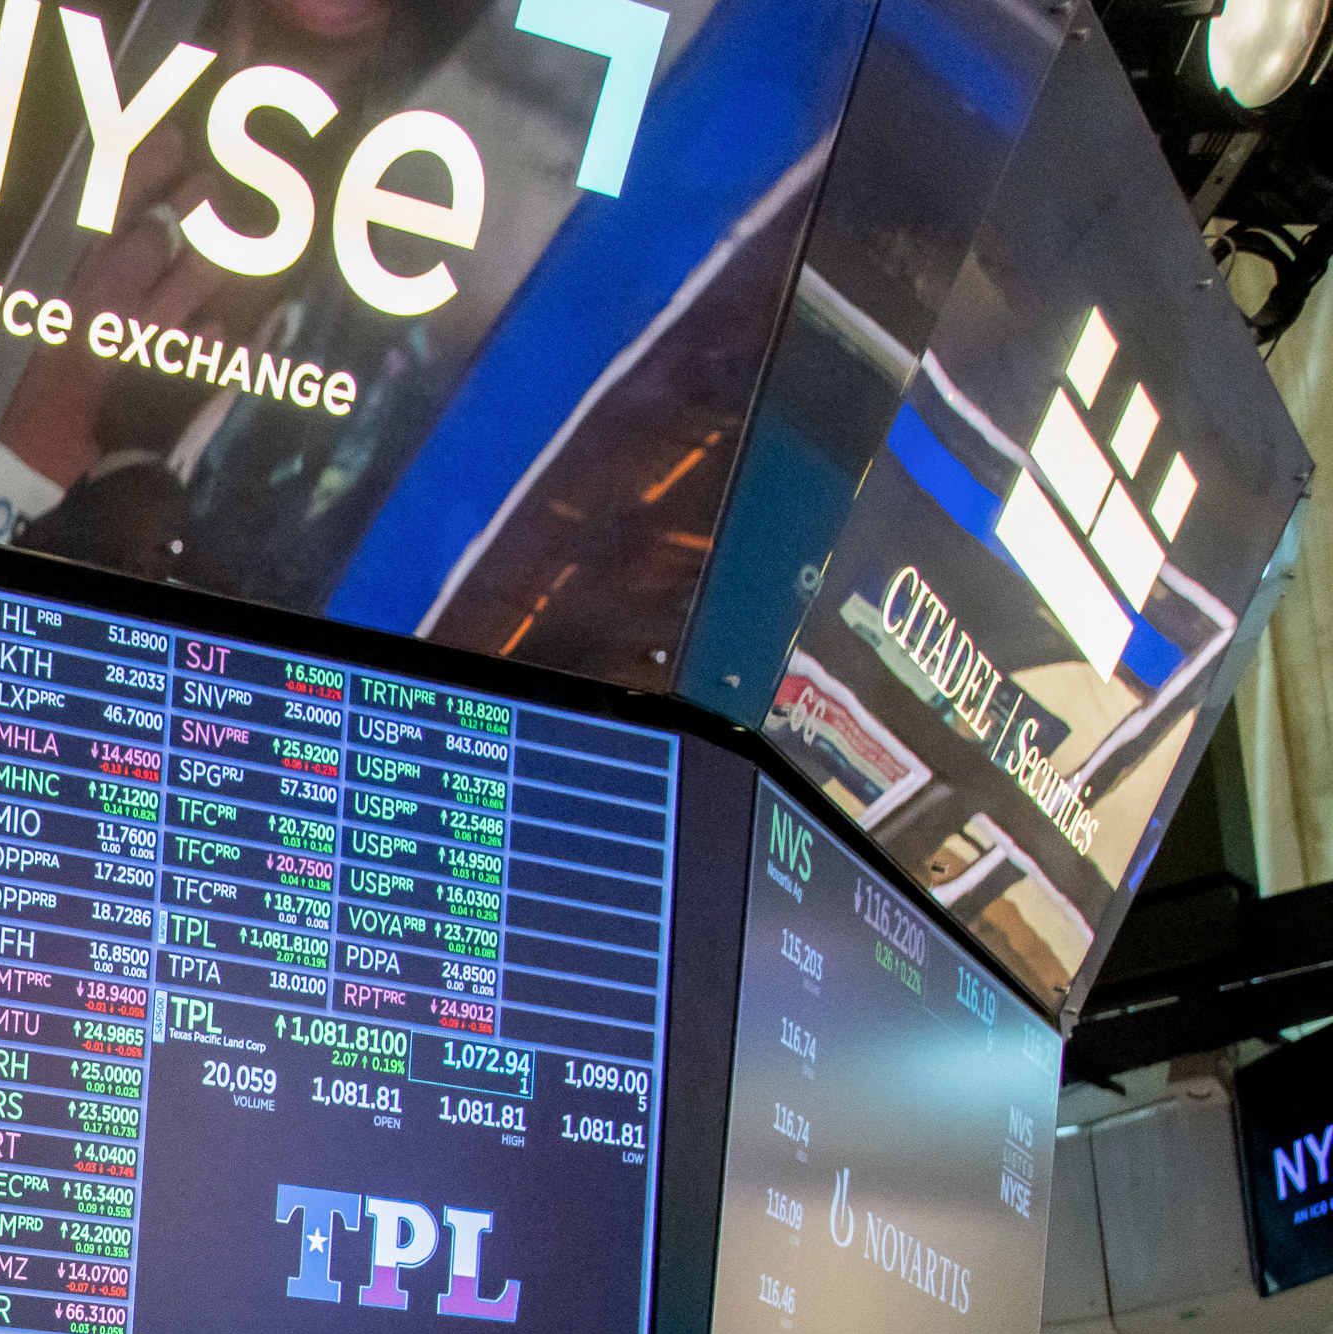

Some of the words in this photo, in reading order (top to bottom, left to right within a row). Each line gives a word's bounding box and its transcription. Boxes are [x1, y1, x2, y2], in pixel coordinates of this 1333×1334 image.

[1, 644, 51, 678] KTH
[187, 642, 230, 673] SJT
[294, 665, 343, 691] 6.5000
[882, 565, 1003, 740] CITADEL
[1006, 718, 1099, 857] Securities
[446, 735, 507, 760] 843.0000
[770, 803, 813, 882] NVS
[864, 885, 926, 966] 116.2200
[347, 945, 399, 974] PDPA
[442, 962, 495, 986] 24.8500
[781, 928, 823, 982] 115,203
[956, 966, 996, 1027] 116.19
[169, 1028, 192, 1041] Texas
[194, 1031, 221, 1045] Pacific
[223, 1036, 244, 1049] Land
[246, 1039, 267, 1053] Corp
[170, 996, 222, 1034] TPL
[291, 1017, 407, 1058] 1,081.8100
[780, 1017, 817, 1064] 116.74
[332, 1050, 358, 1066] 2.07
[372, 1057, 405, 1074] 0.19%
[443, 1039, 529, 1077] 1,072.94
[202, 1061, 276, 1094] 20,059
[312, 1077, 401, 1113] 1,081.81
[520, 1075, 528, 1094] 1
[565, 1061, 647, 1095] 1,099.00
[234, 1096, 274, 1111] VOLUME
[374, 1116, 399, 1128] OPEN
[439, 1096, 528, 1131] 1,081.81
[638, 1096, 646, 1111] 5
[501, 1132, 525, 1147] HIGH
[562, 1115, 644, 1148] 1,081.81
[774, 1102, 810, 1148] 116.74
[622, 1150, 644, 1164] LOW
[1273, 1124, 1333, 1200] NY
[766, 1188, 802, 1230] 116.09
[1000, 1172, 1031, 1218] NYSE
[275, 1183, 521, 1323] TPL
[864, 1211, 971, 1314] NOVARTIS
